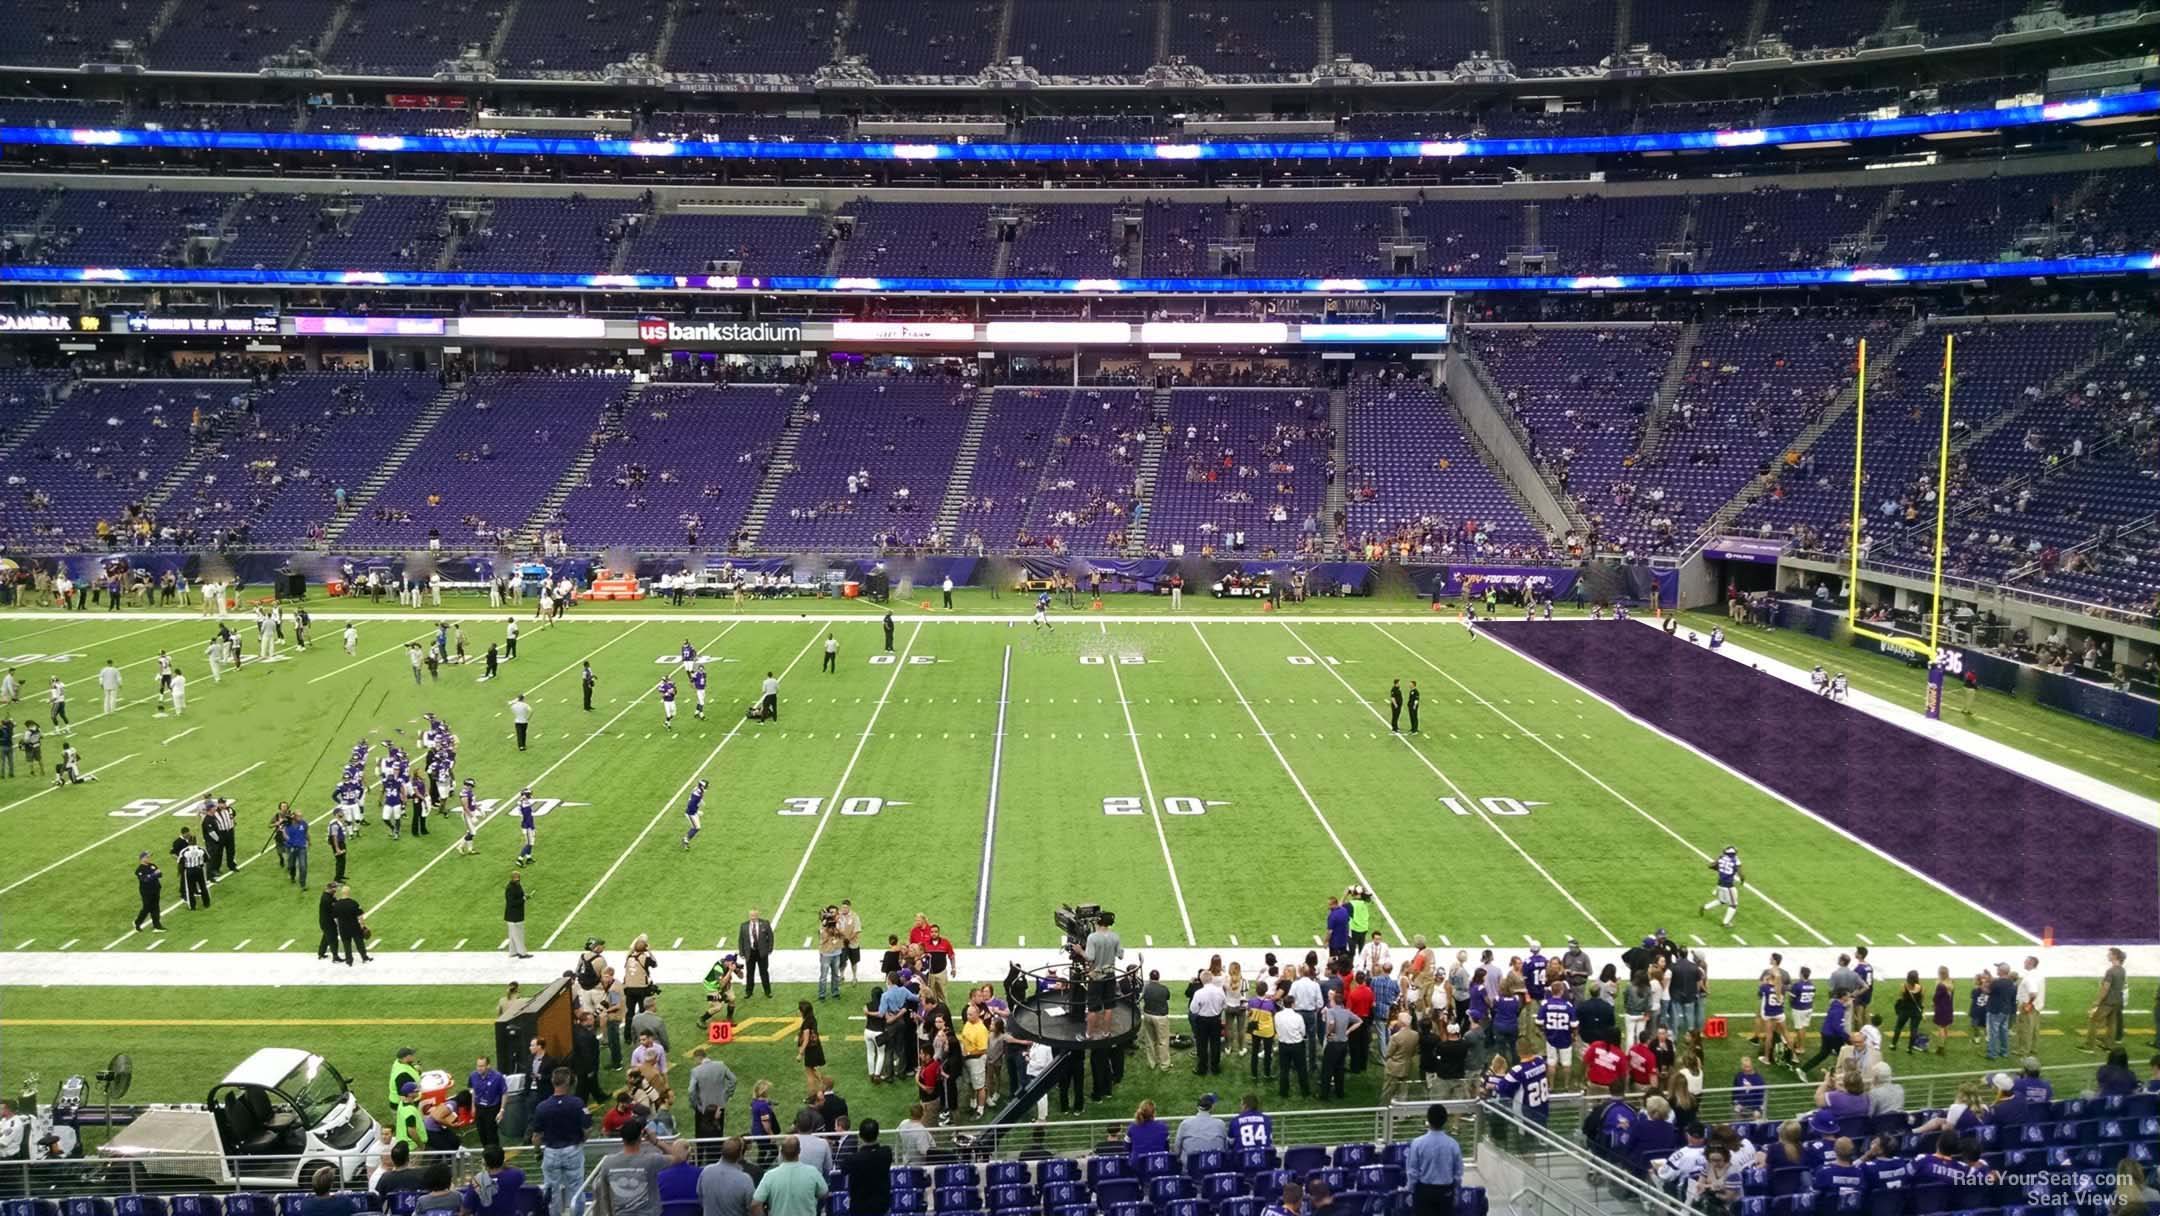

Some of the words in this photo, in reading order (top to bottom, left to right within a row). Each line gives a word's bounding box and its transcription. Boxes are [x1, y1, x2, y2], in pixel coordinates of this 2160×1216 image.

[384, 787, 398, 798] 34
[776, 796, 884, 816] 30
[1102, 796, 1207, 816] 20
[1437, 796, 1532, 816] 10
[1533, 969, 1548, 985] 14
[1546, 1012, 1571, 1031] 52
[1710, 1021, 1726, 1038] 10
[712, 1024, 729, 1040] 30
[1527, 1077, 1550, 1108] 28
[1240, 1124, 1268, 1147] 84
